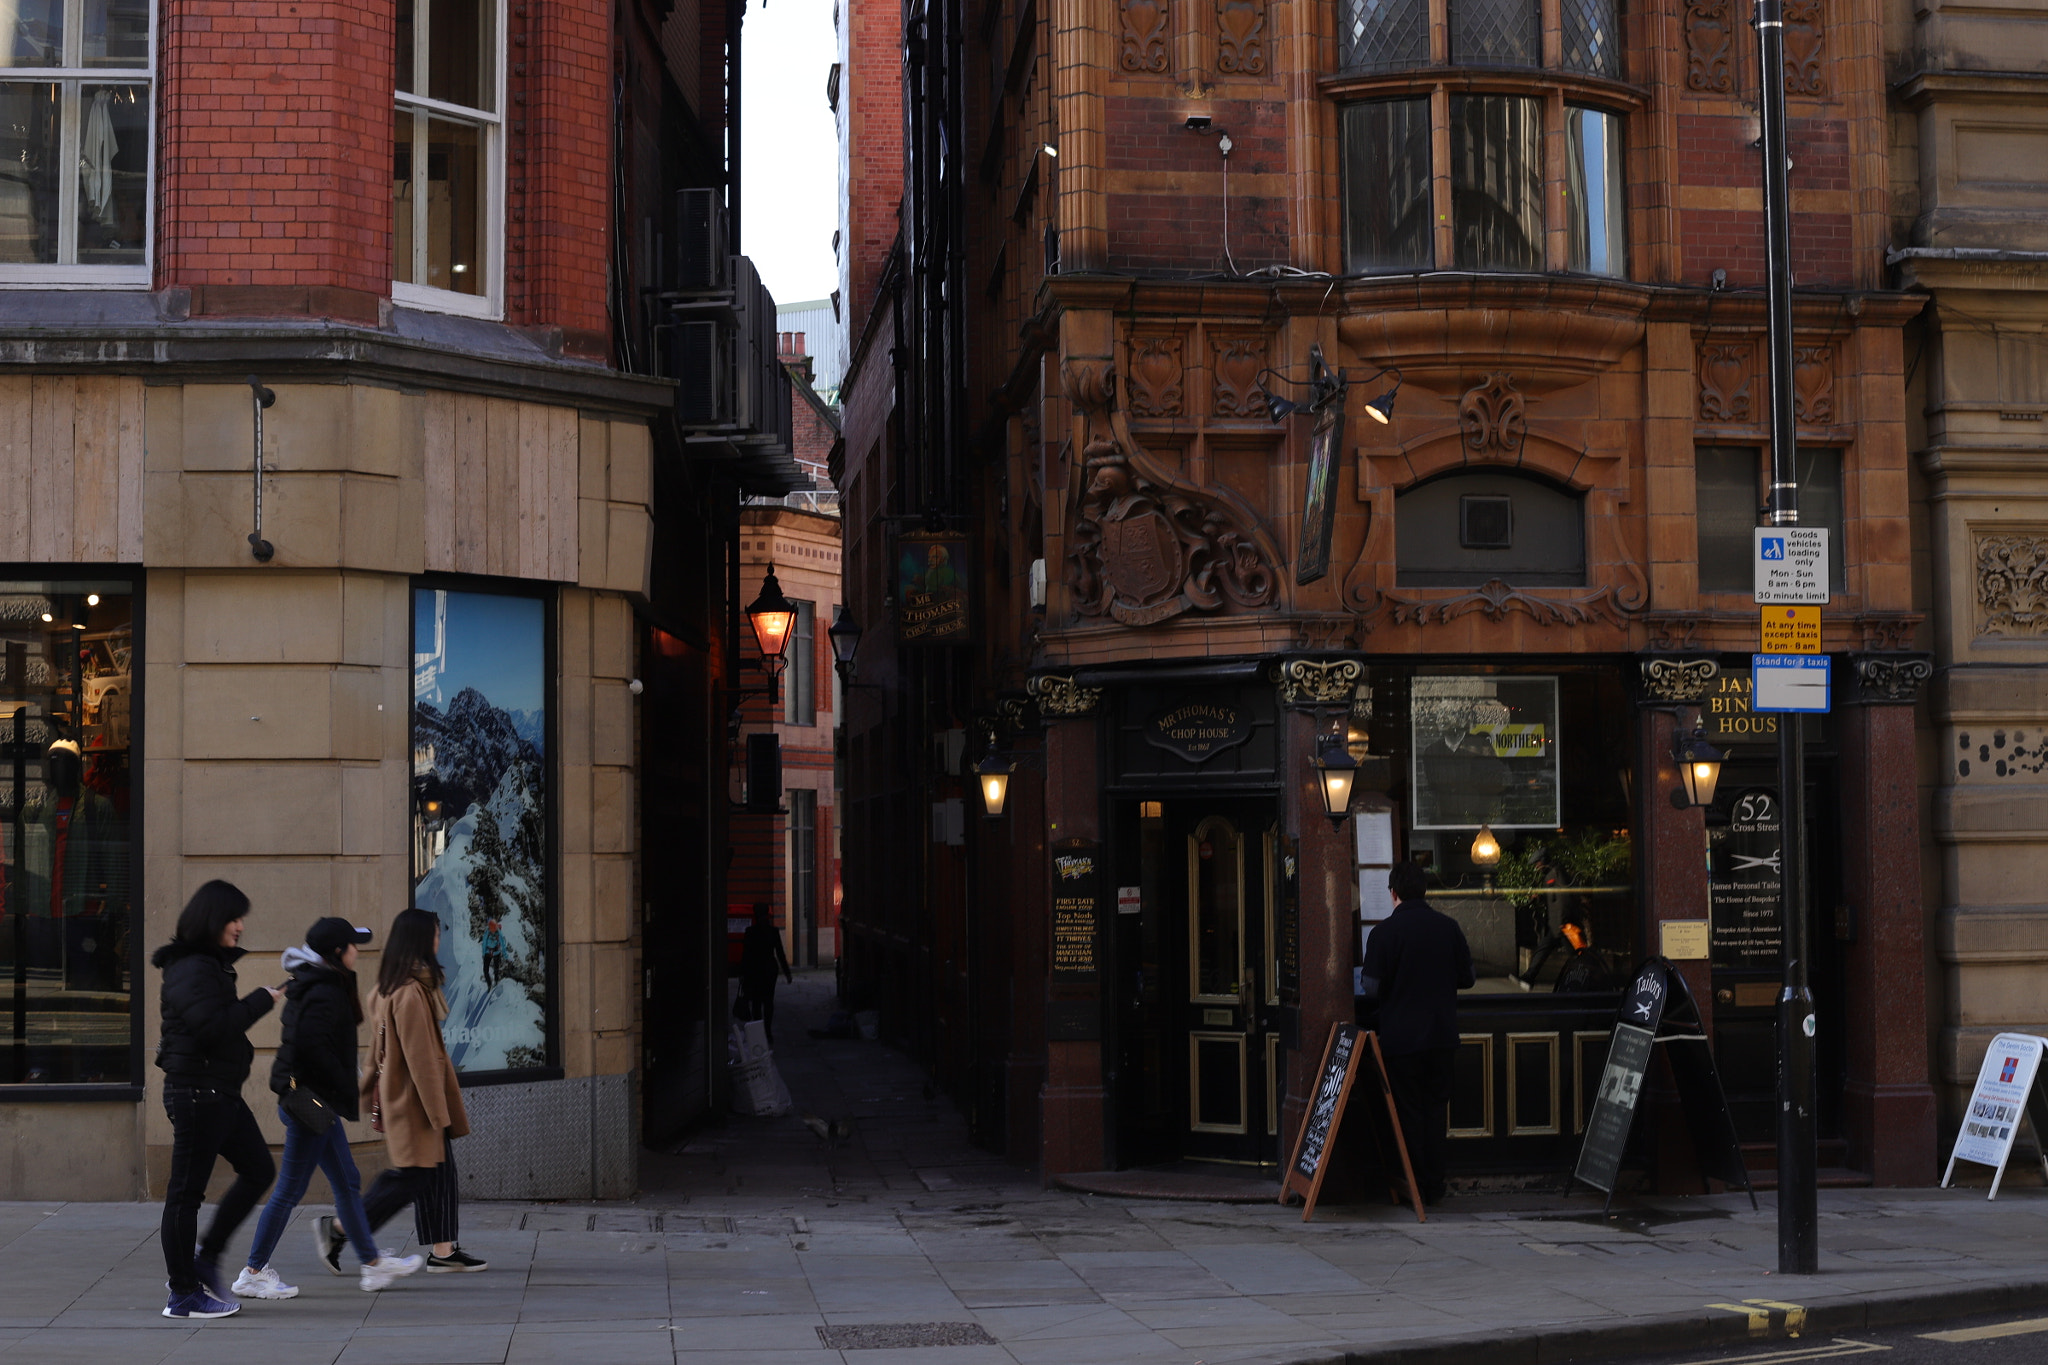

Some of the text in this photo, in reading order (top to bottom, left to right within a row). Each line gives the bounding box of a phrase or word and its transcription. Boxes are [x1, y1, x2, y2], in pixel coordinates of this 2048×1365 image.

[1787, 540, 1822, 548] vehicles
[1788, 549, 1820, 558] loading
[1795, 559, 1814, 567] only
[1770, 570, 1789, 578] Mon
[1796, 570, 1813, 578] Sun
[1795, 580, 1801, 588] 6
[1758, 592, 1826, 600] 30 minute limit
[1766, 621, 1776, 629] At
[1797, 621, 1817, 629] time
[1764, 631, 1794, 639] except
[1767, 642, 1773, 650] 6
[1795, 642, 1801, 650] 8
[1755, 657, 1828, 666] Stand for 6 taxis
[1157, 704, 1236, 732] MR THOMAS'S
[1171, 728, 1229, 739] CHOP HOUSE
[1495, 734, 1542, 748] NORTHERN
[1740, 794, 1772, 822] 52
[1732, 822, 1780, 832] Cross Street
[1712, 882, 1732, 890] James
[1732, 881, 1760, 890] Personal
[1056, 897, 1077, 905] FIRST
[1714, 896, 1726, 904] The
[1726, 896, 1743, 904] Home
[1056, 911, 1093, 920] Top Nosh
[1635, 972, 1662, 1000] Tailors
